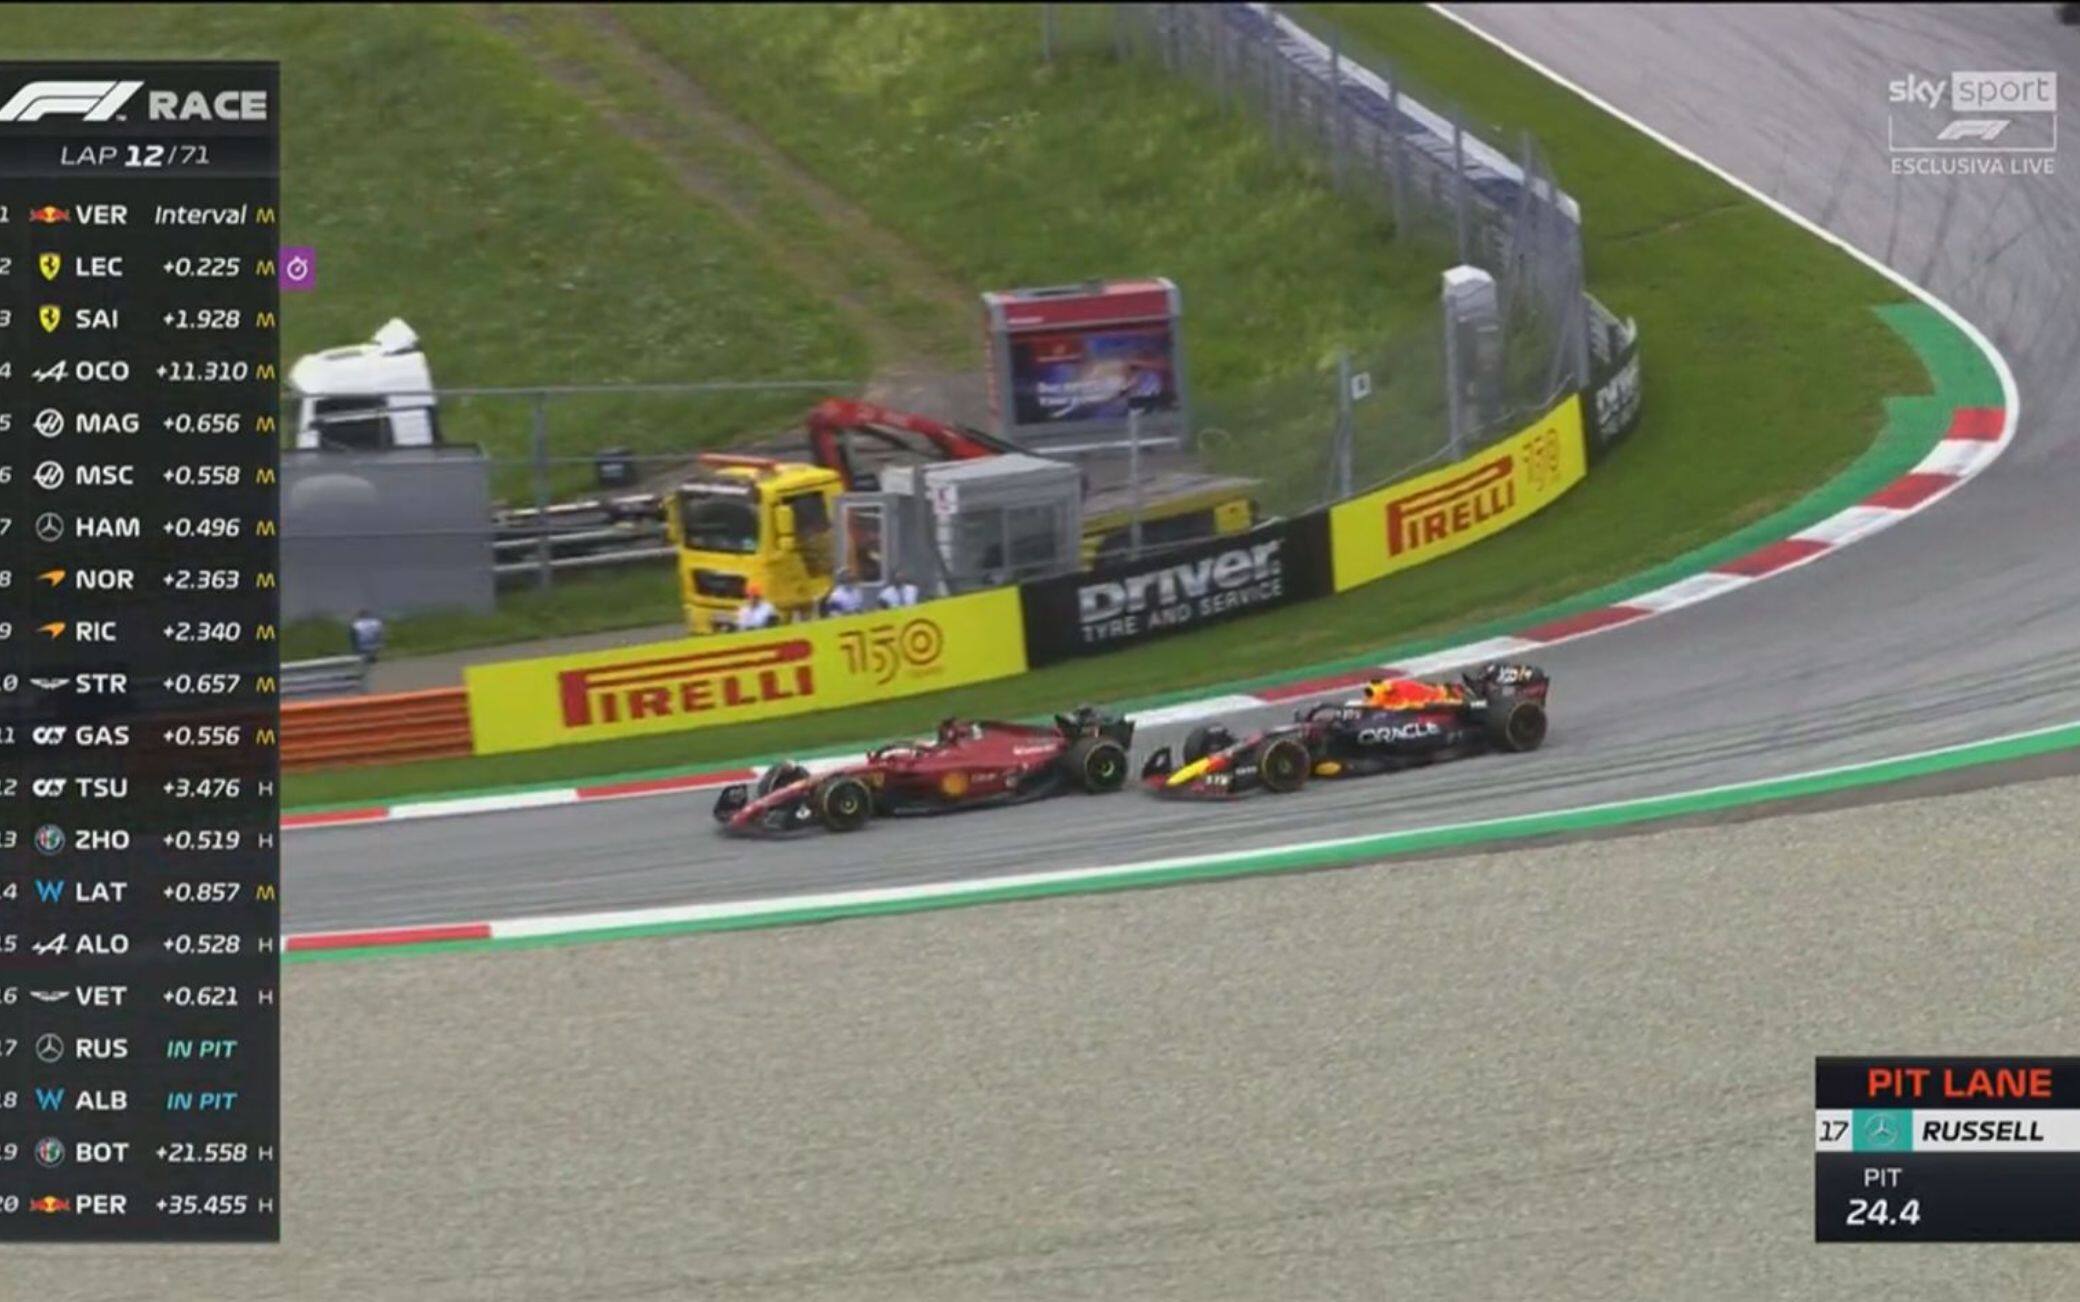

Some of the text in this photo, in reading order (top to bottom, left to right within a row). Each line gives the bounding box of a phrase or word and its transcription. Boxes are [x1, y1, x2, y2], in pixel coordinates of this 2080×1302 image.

[1385, 453, 1516, 558] PIRELLI
[1081, 614, 1139, 642] TYRE
[1199, 578, 1283, 617] SERVICE
[558, 638, 815, 728] PIRELLI
[1357, 721, 1441, 745] ORACLE
